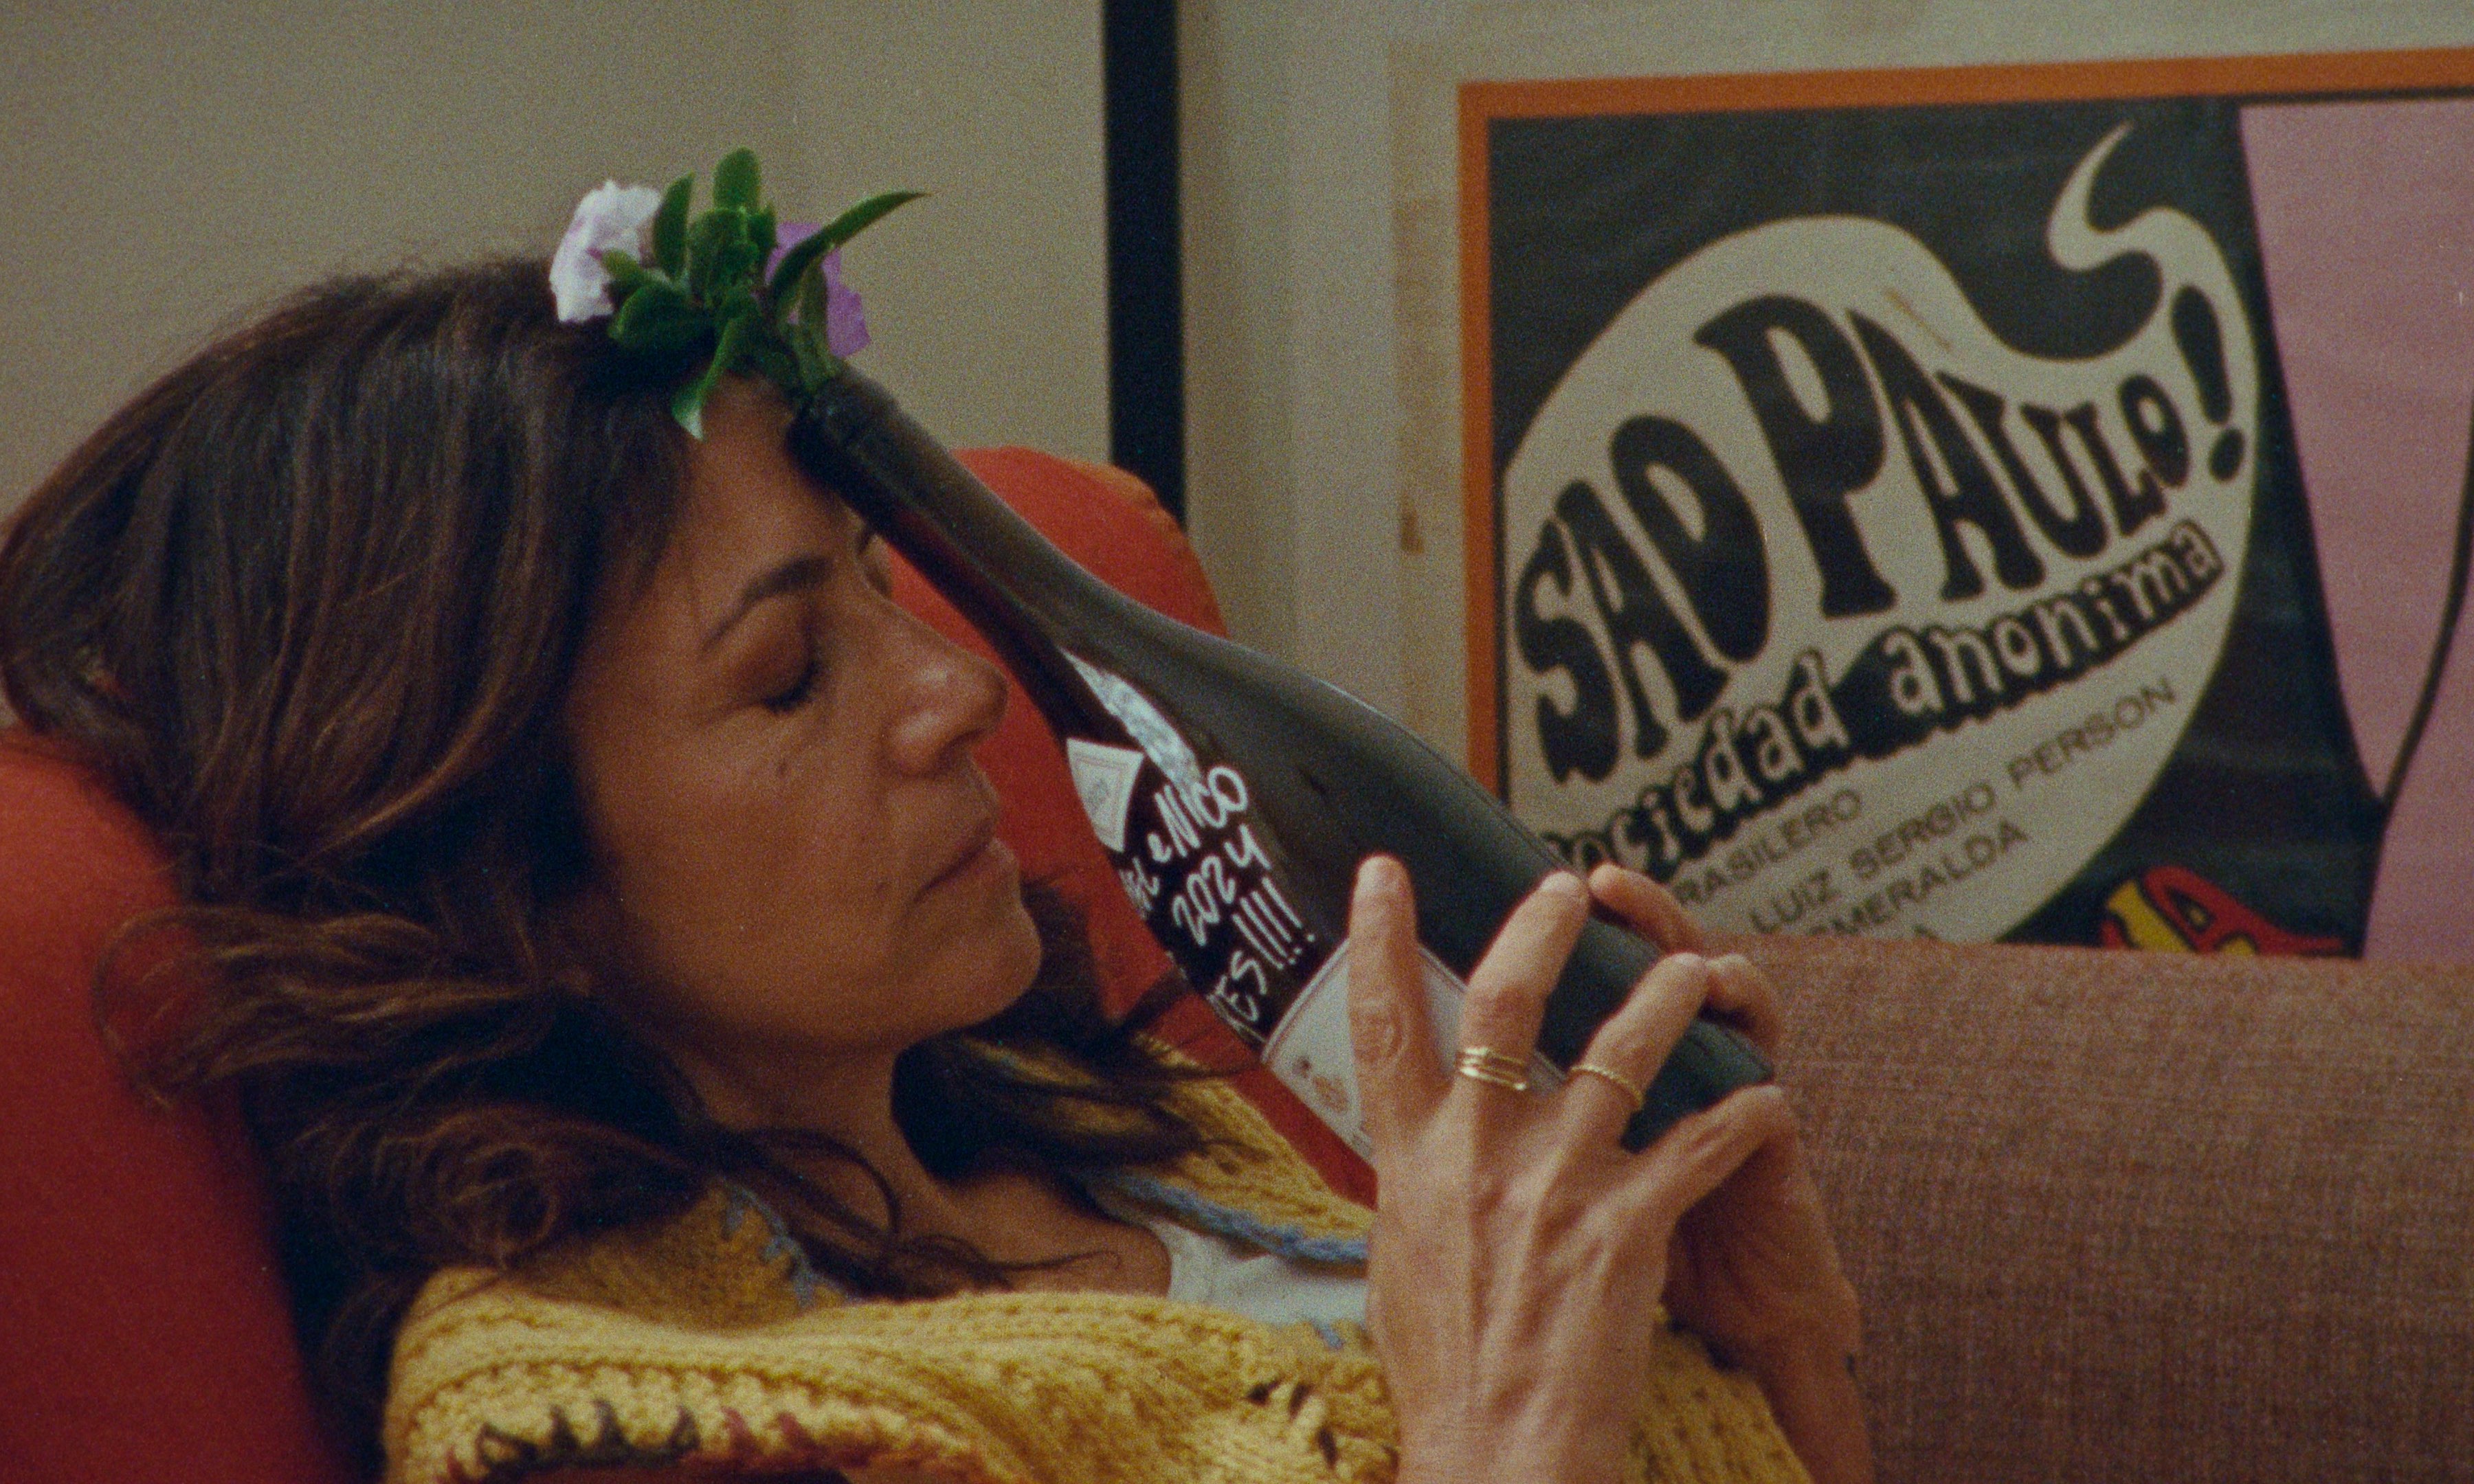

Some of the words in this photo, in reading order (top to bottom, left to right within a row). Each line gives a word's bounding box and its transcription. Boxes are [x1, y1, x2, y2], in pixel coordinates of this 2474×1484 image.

[1693, 285, 2245, 618] PAULO!
[1539, 646, 1850, 871] ociedad
[1880, 524, 2223, 715] anonima
[1171, 824, 1273, 947] 2024
[1675, 790, 1861, 904] RASILERO
[1750, 867, 1832, 934] LUIZ
[1849, 781, 1993, 879] SERGIO
[2005, 676, 2177, 789] PERSON
[1806, 820, 2029, 936] MERALDA
